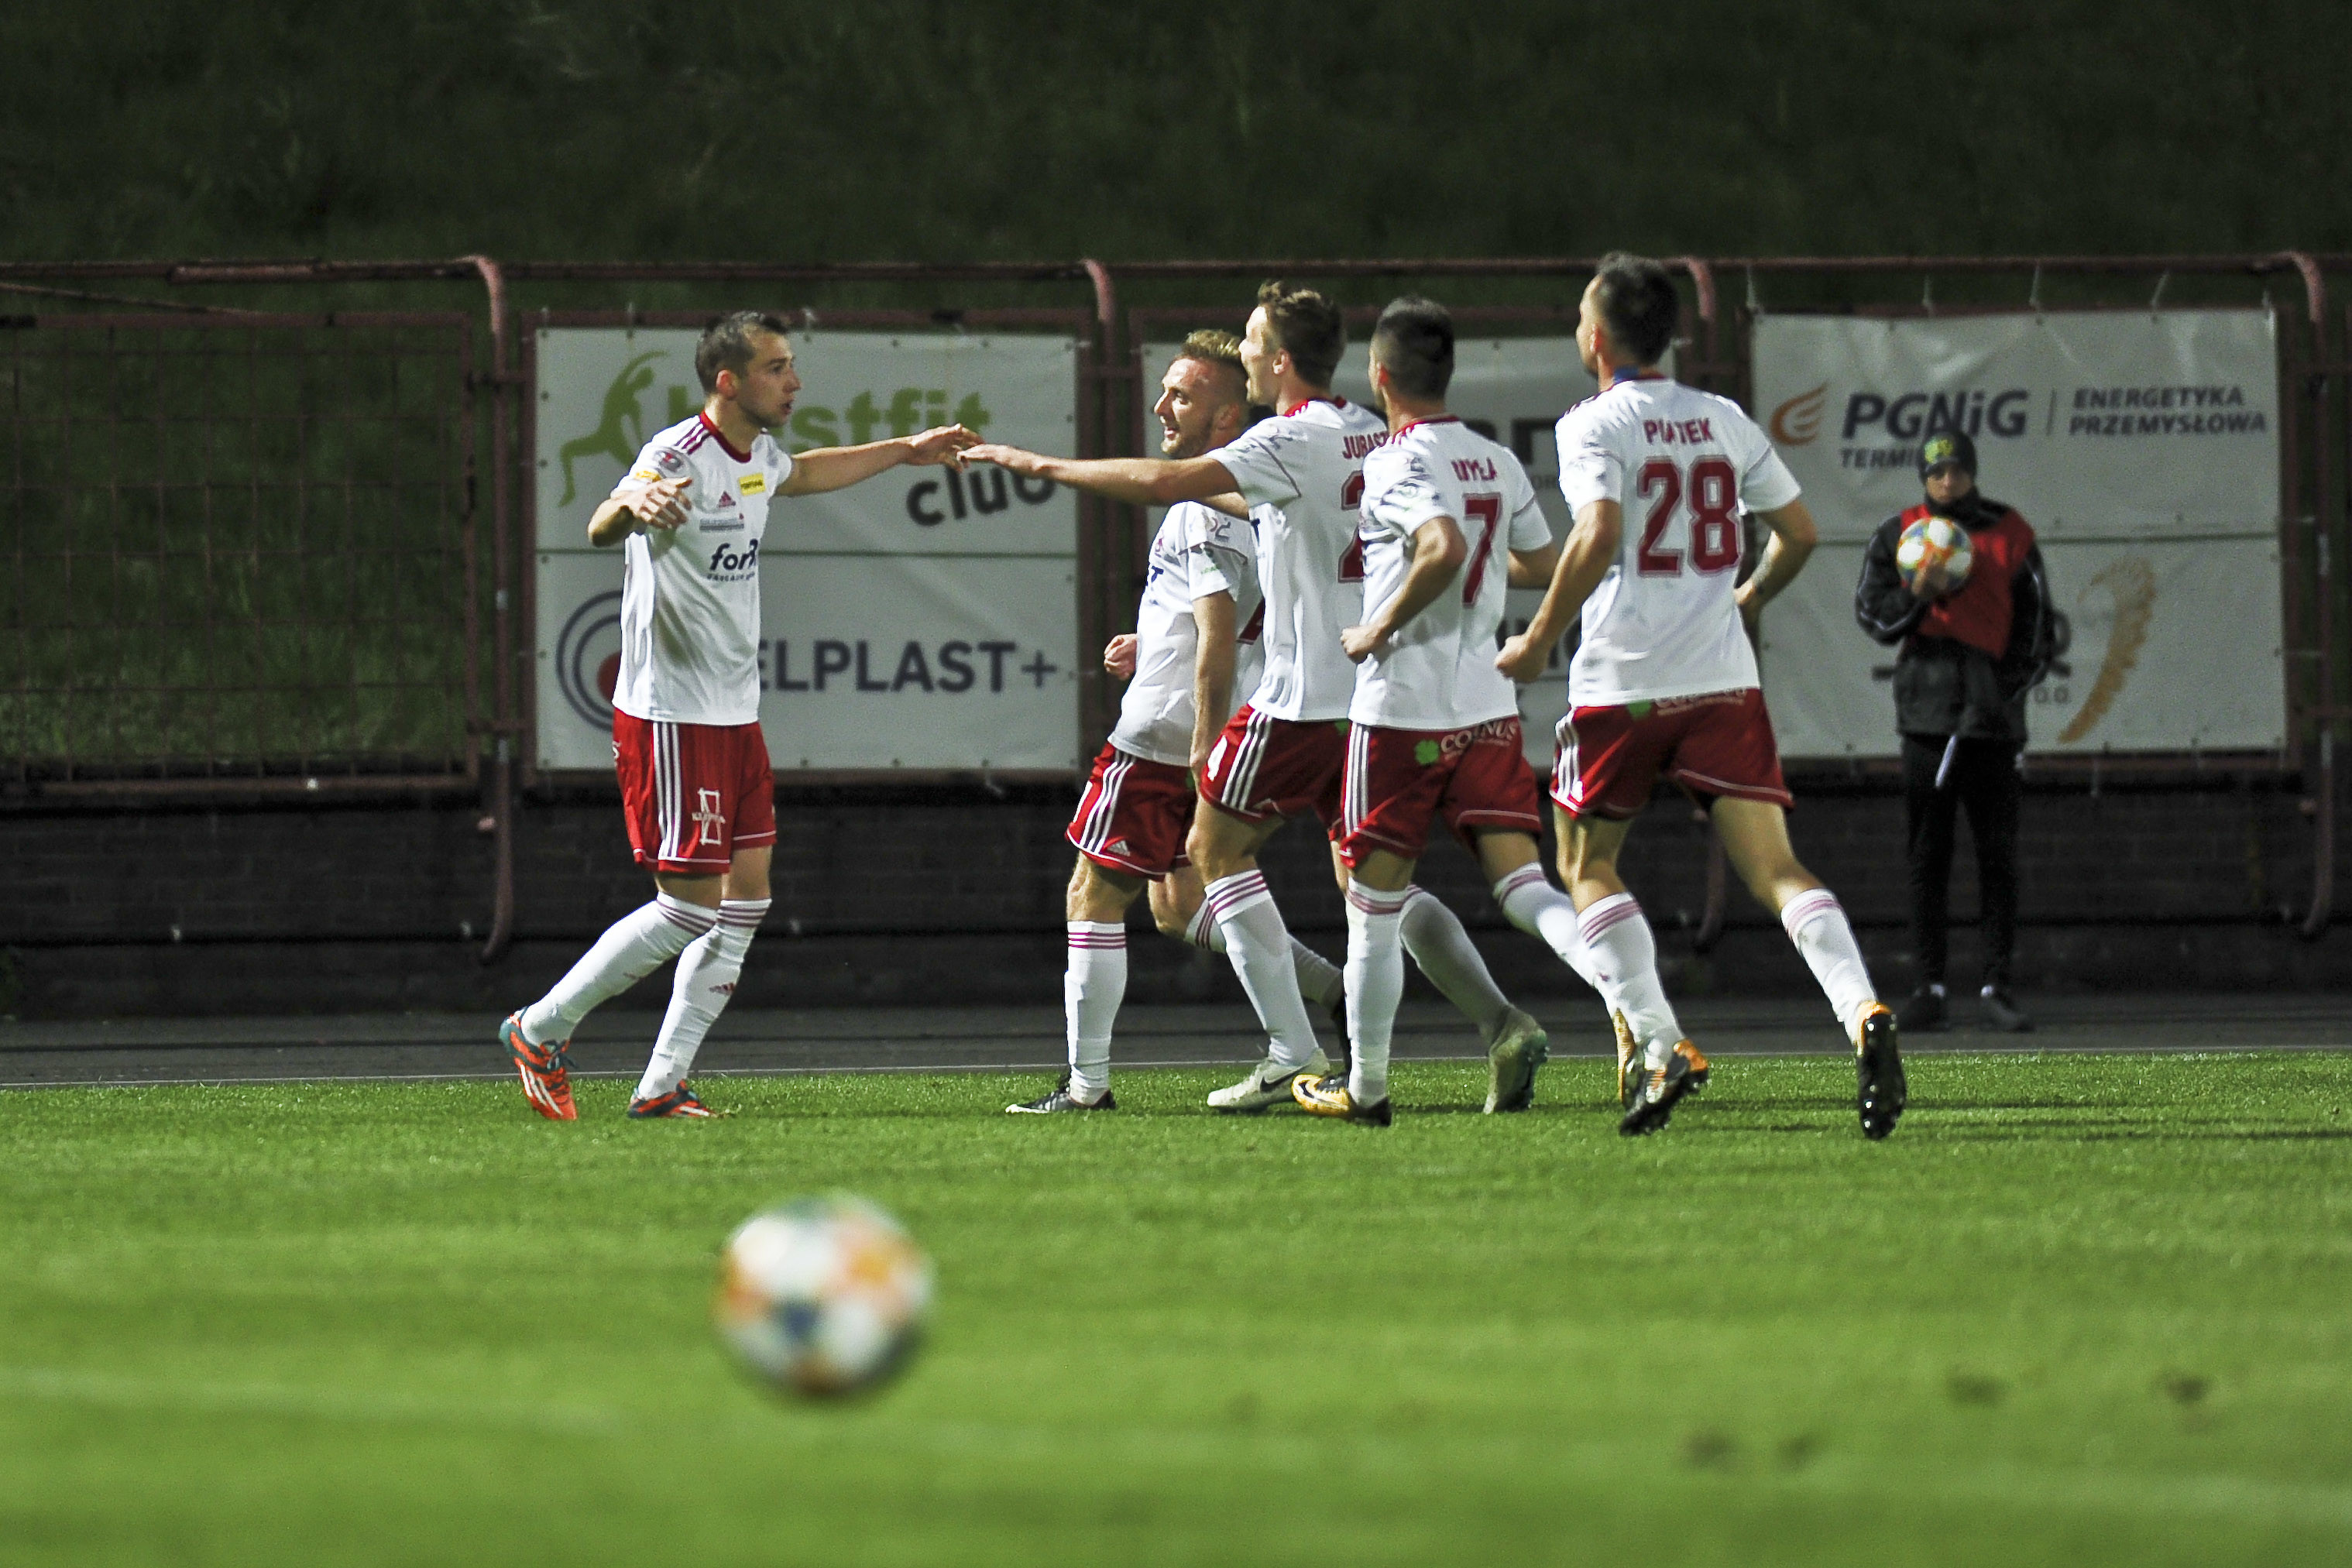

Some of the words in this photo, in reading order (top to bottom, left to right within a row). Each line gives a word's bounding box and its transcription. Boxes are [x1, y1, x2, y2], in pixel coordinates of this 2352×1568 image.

[1842, 389, 2029, 439] PGNiG
[2073, 386, 2244, 409] ENERGETYKA
[2069, 413, 2266, 435] PRZEMYSŁOWA
[1842, 448, 1921, 468] TERMI
[1636, 455, 1744, 578] 28
[1461, 492, 1502, 609] 7
